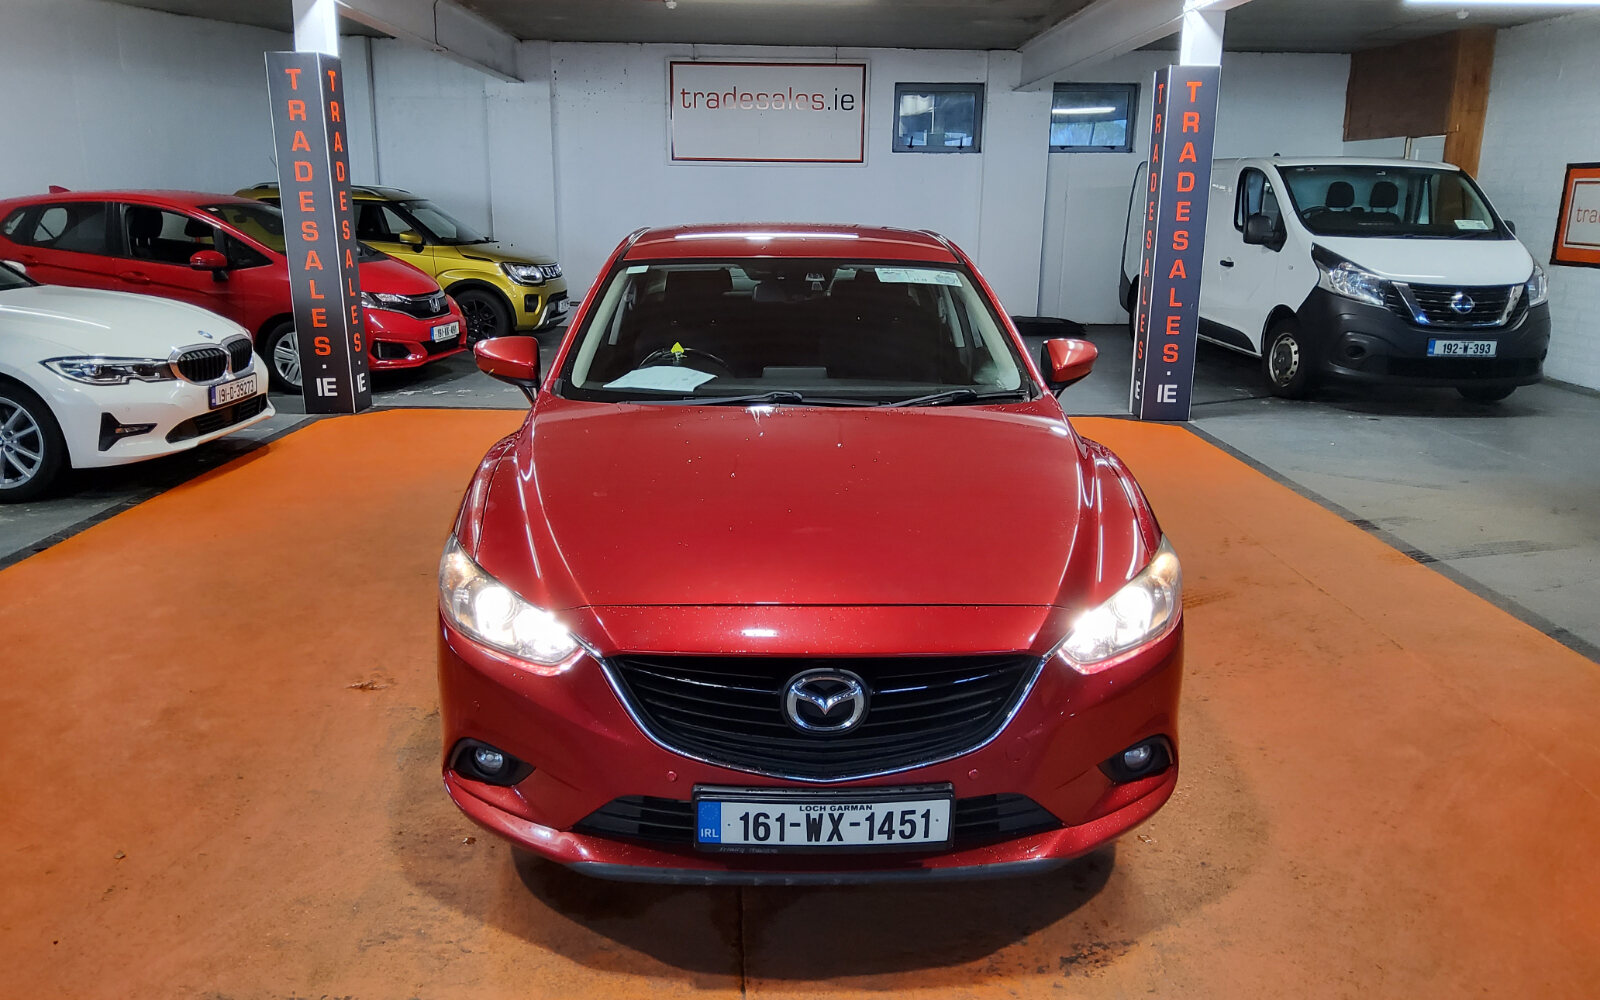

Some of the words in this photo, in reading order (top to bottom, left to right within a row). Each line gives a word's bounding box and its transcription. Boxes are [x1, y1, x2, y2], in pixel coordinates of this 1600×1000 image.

[680, 86, 855, 111] tradesales.ie
[1576, 207, 1600, 224] tra
[285, 68, 338, 397] TRADESALES.IE
[1156, 81, 1203, 403] TRADESALES.IE
[1442, 343, 1492, 354] 192-W-393
[829, 804, 873, 812] GARMAN
[700, 828, 719, 838] IRL
[739, 808, 932, 842] 161-WX-1451
